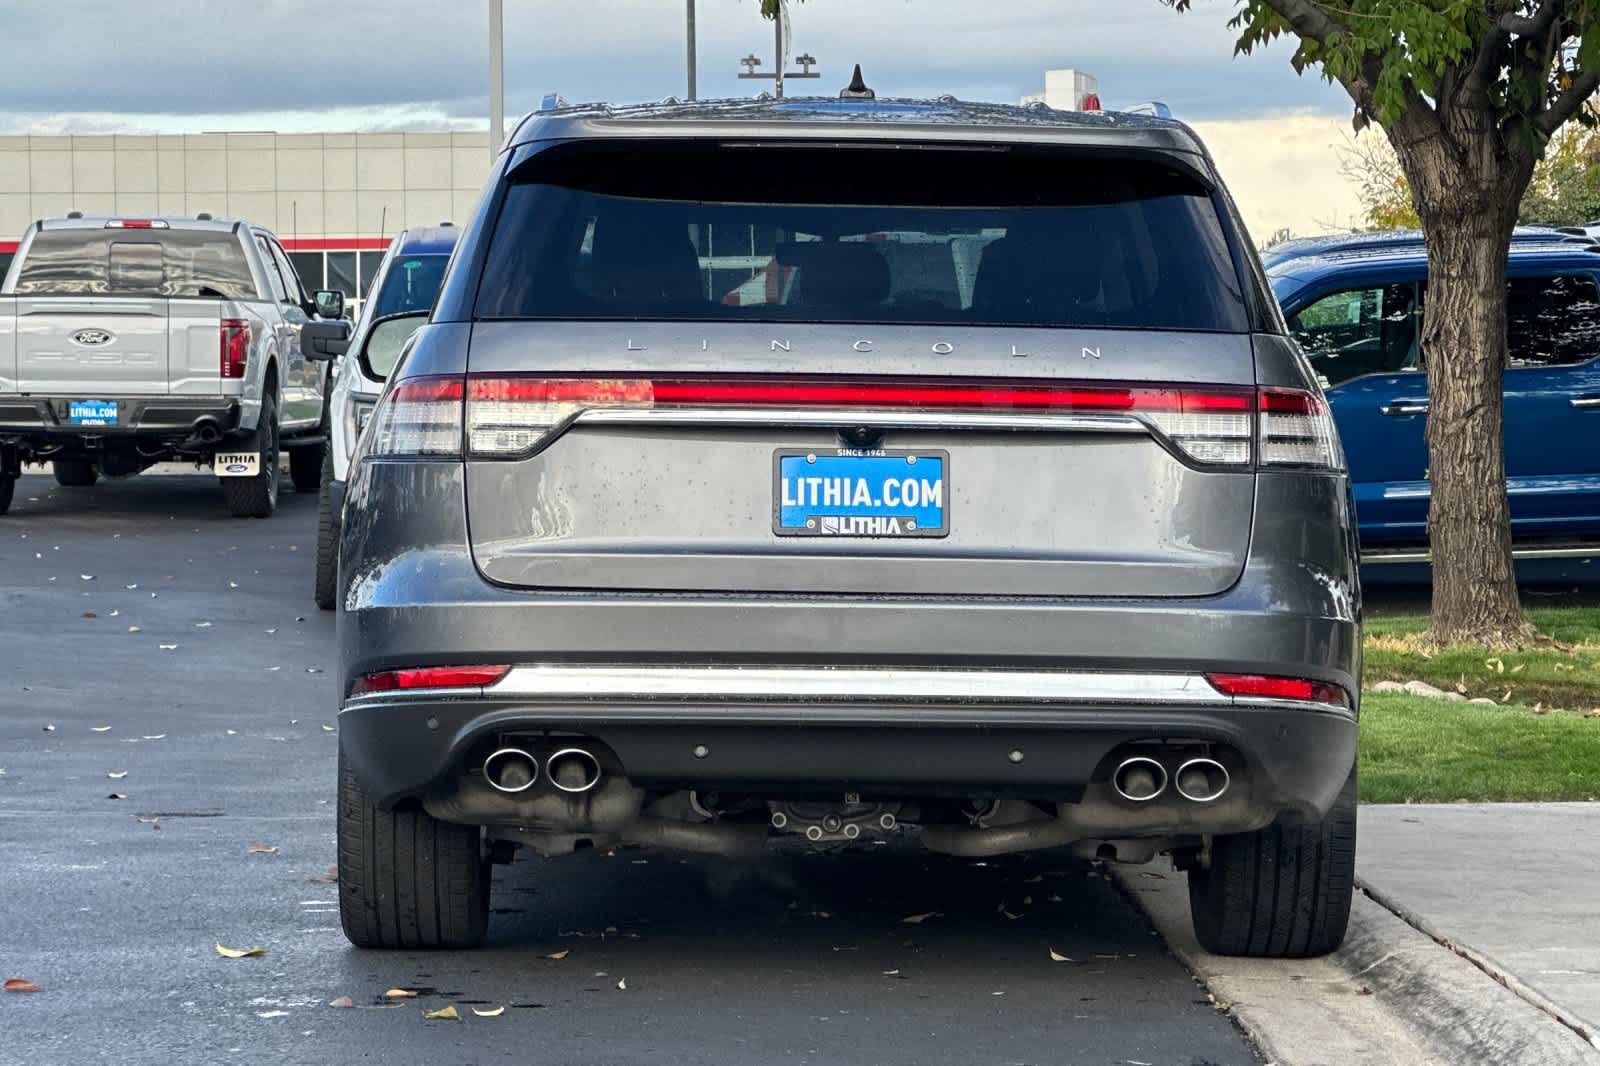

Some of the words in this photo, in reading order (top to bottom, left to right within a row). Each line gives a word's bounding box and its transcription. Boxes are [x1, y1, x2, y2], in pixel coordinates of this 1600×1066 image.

[79, 331, 106, 343] Ford
[627, 338, 1102, 359] LINCOLN
[71, 408, 117, 417] LITHIA.COM
[782, 477, 942, 508] LITHIA.COM
[839, 517, 901, 534] LITHIA
